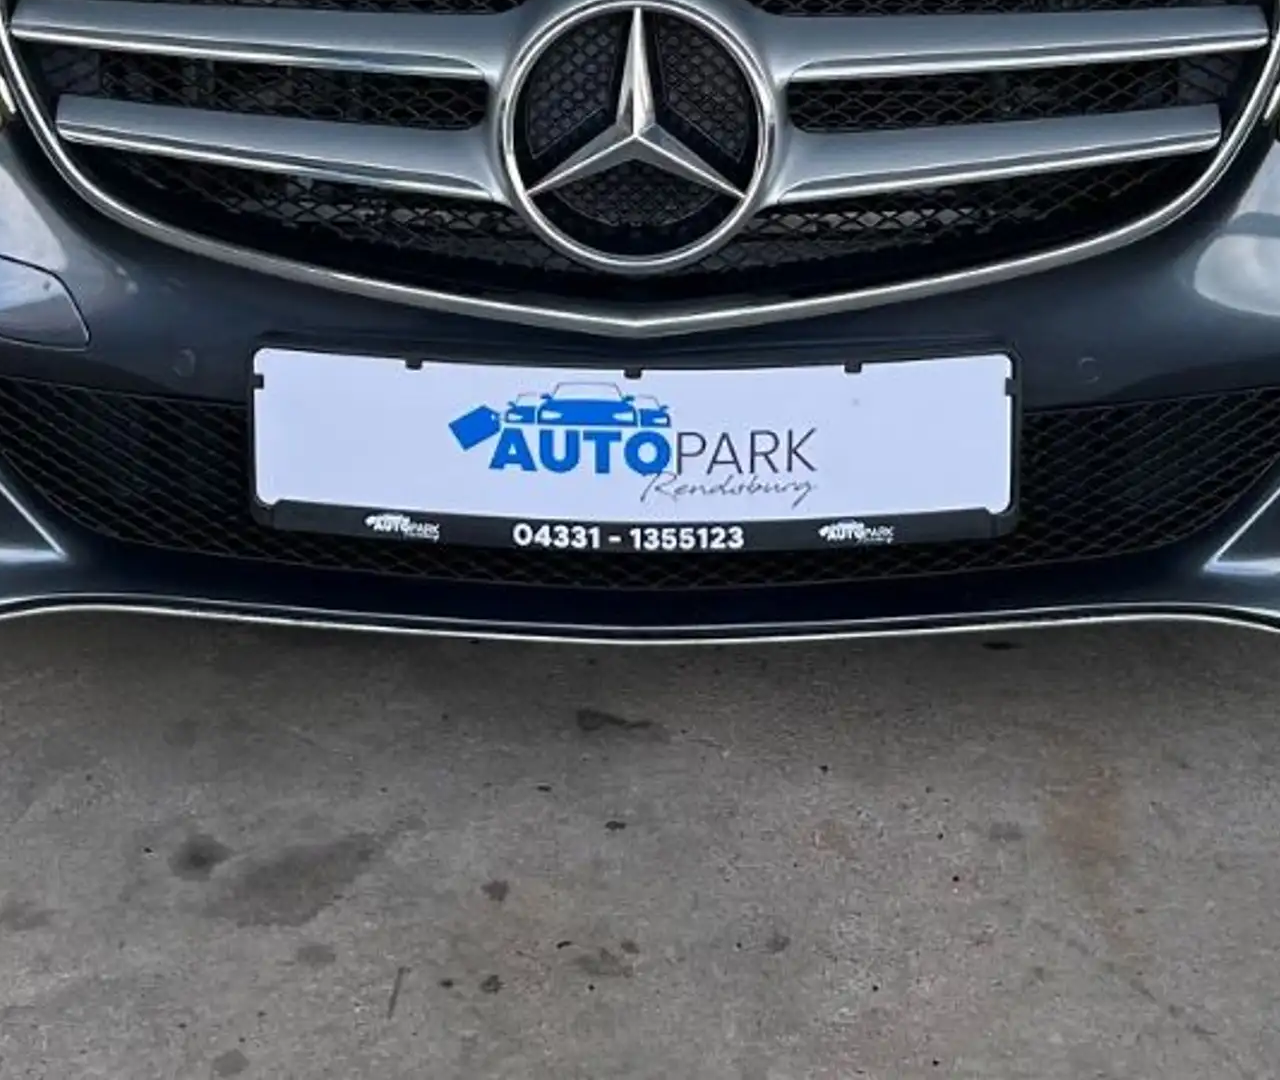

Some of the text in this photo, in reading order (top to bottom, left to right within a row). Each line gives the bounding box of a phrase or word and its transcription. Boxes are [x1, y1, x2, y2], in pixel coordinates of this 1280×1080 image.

[488, 427, 819, 475] AUTOPARK
[512, 522, 601, 550] 04331
[629, 525, 745, 551] 1355123
